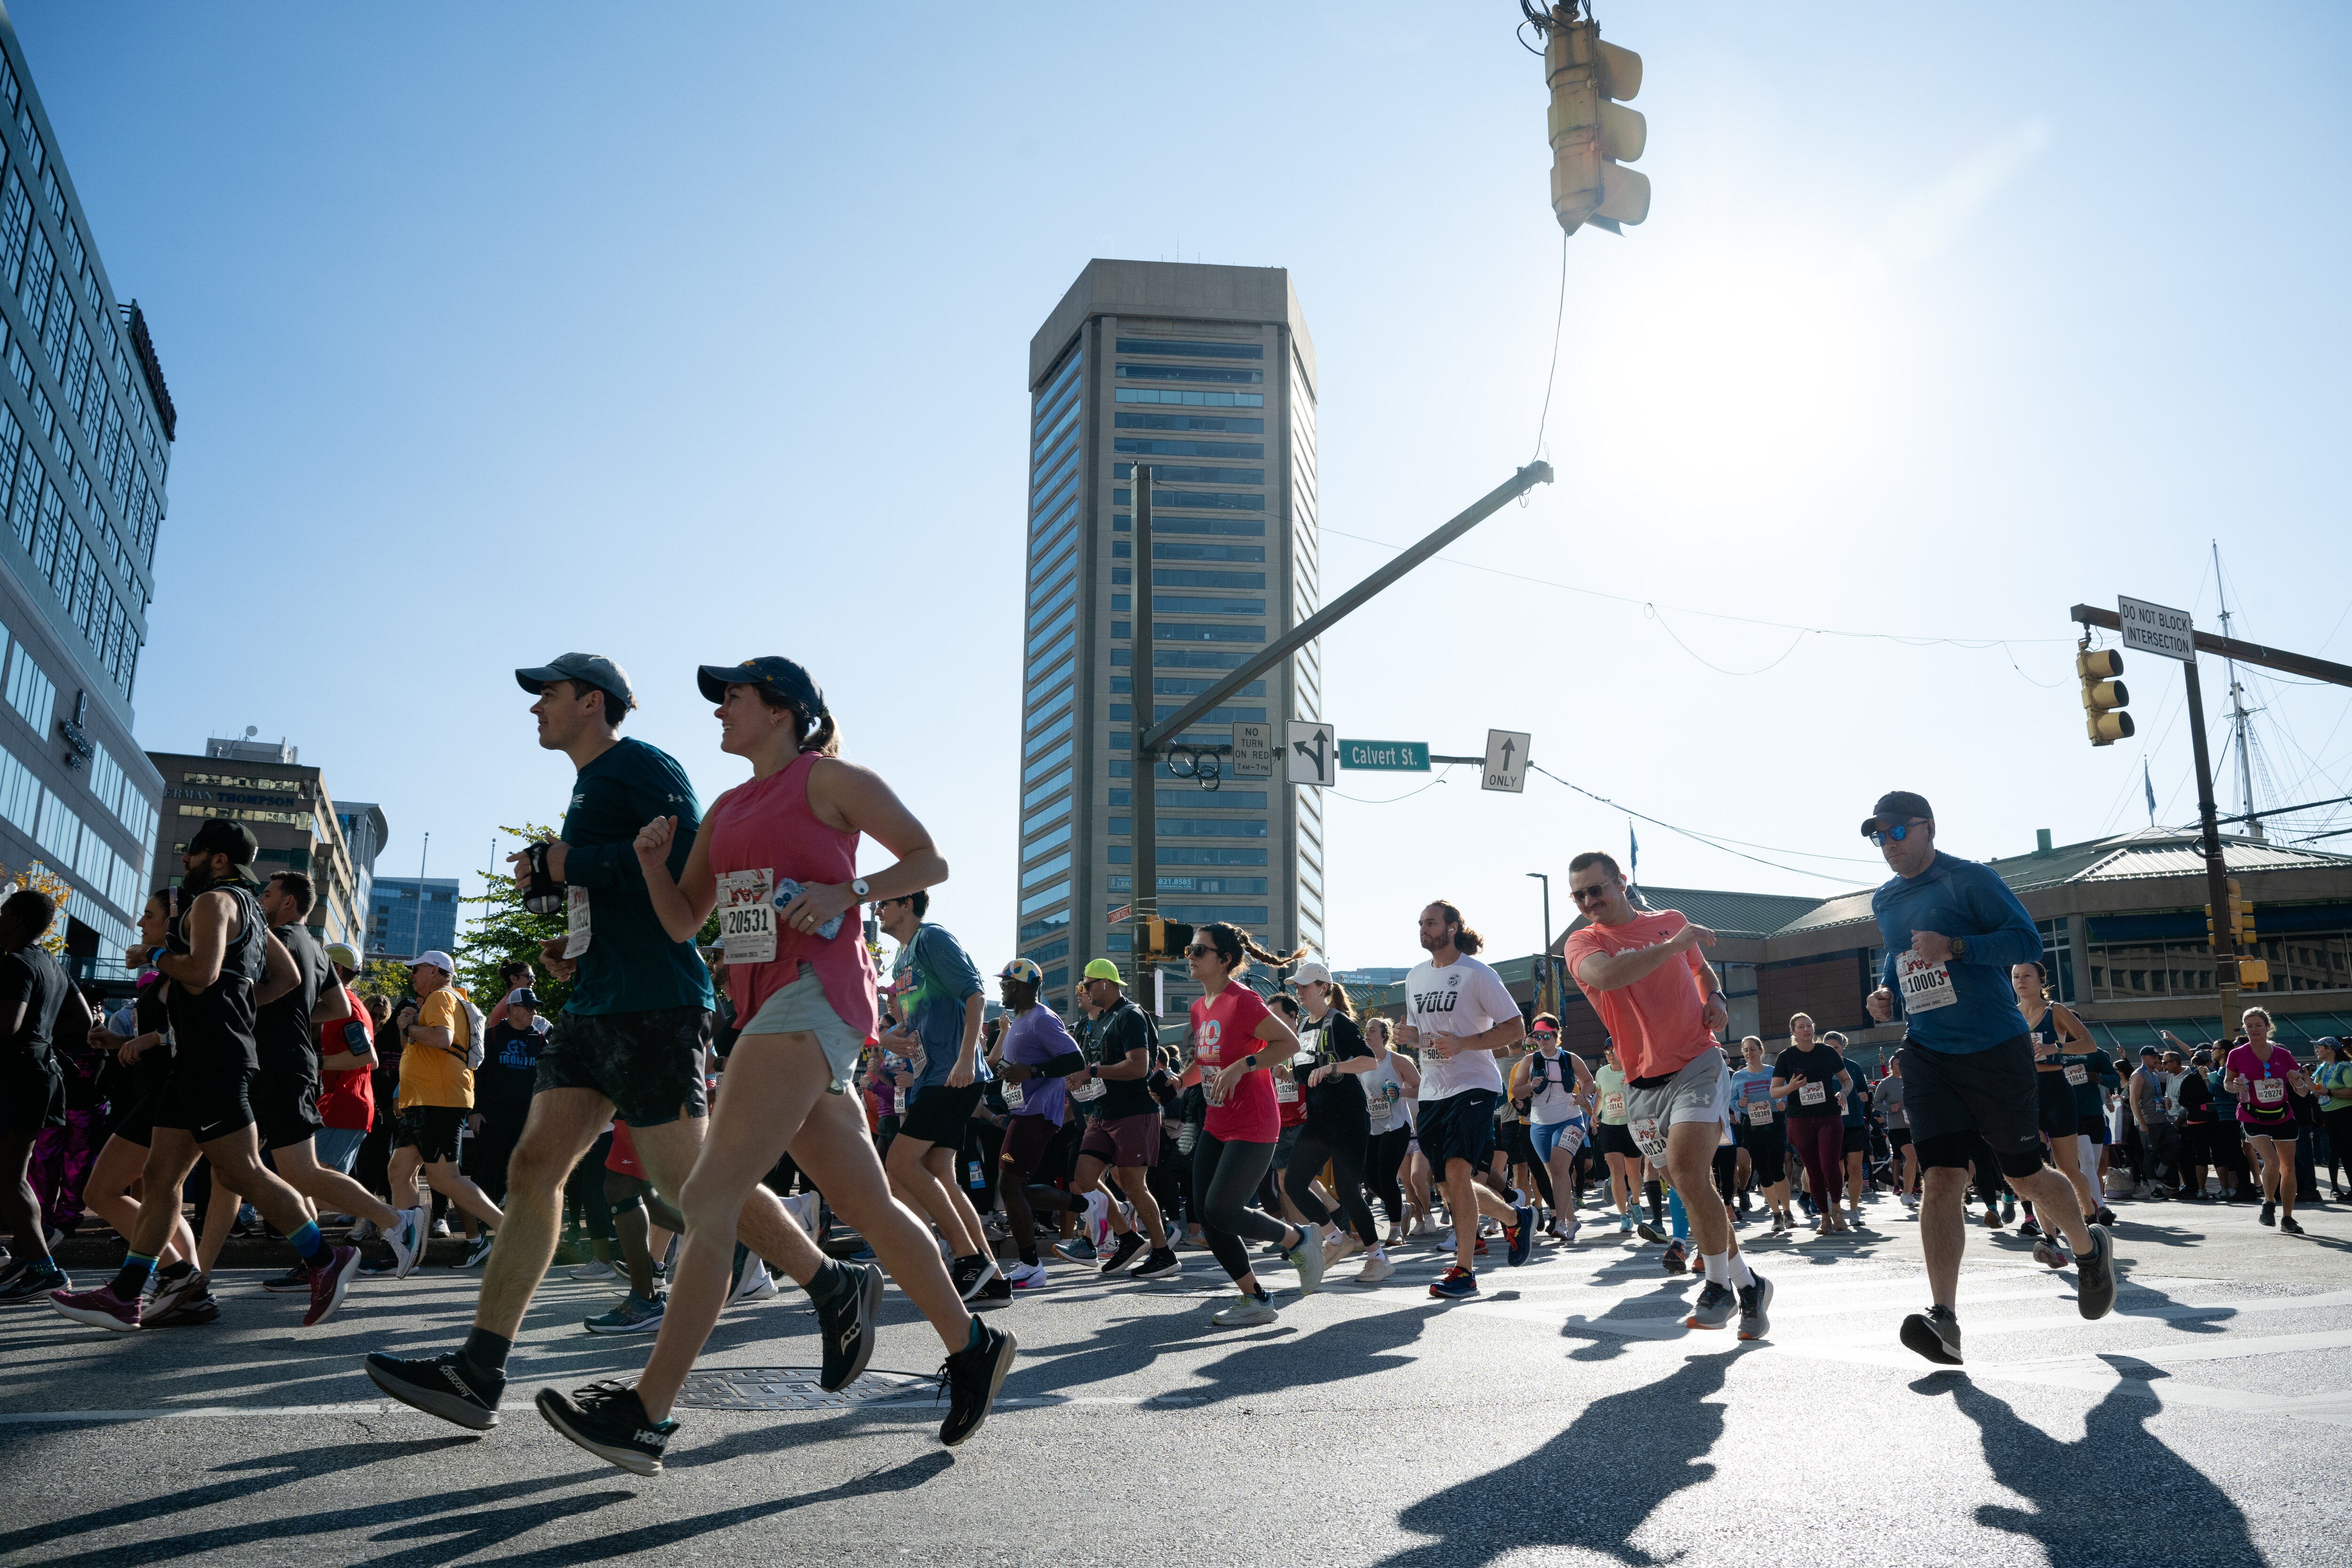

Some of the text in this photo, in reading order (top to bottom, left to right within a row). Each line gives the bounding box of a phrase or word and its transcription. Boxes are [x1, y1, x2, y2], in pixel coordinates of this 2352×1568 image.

[2122, 604, 2189, 633] DO NOT BLOCK
[2127, 626, 2189, 653] INTERSECTION
[1241, 739, 1263, 748] TURN
[1235, 750, 1246, 758] ON
[1352, 746, 1417, 765] Calvert St.
[1490, 775, 1517, 787] ONLY
[218, 792, 294, 807] THOMPSON
[729, 908, 768, 934] 20531
[1907, 970, 1945, 993] 10003
[1414, 991, 1458, 1014] VOLO
[1198, 1045, 1220, 1059] MILE
[2069, 1073, 2084, 1082] 10647
[1006, 1090, 1022, 1104] 50558
[1806, 1091, 1824, 1101] 30598
[2264, 1089, 2282, 1098] 20274
[1372, 1103, 1388, 1111] 20606
[1642, 1138, 1667, 1156] 40134
[439, 1365, 471, 1397] saucony
[633, 1429, 668, 1448] HOKA
